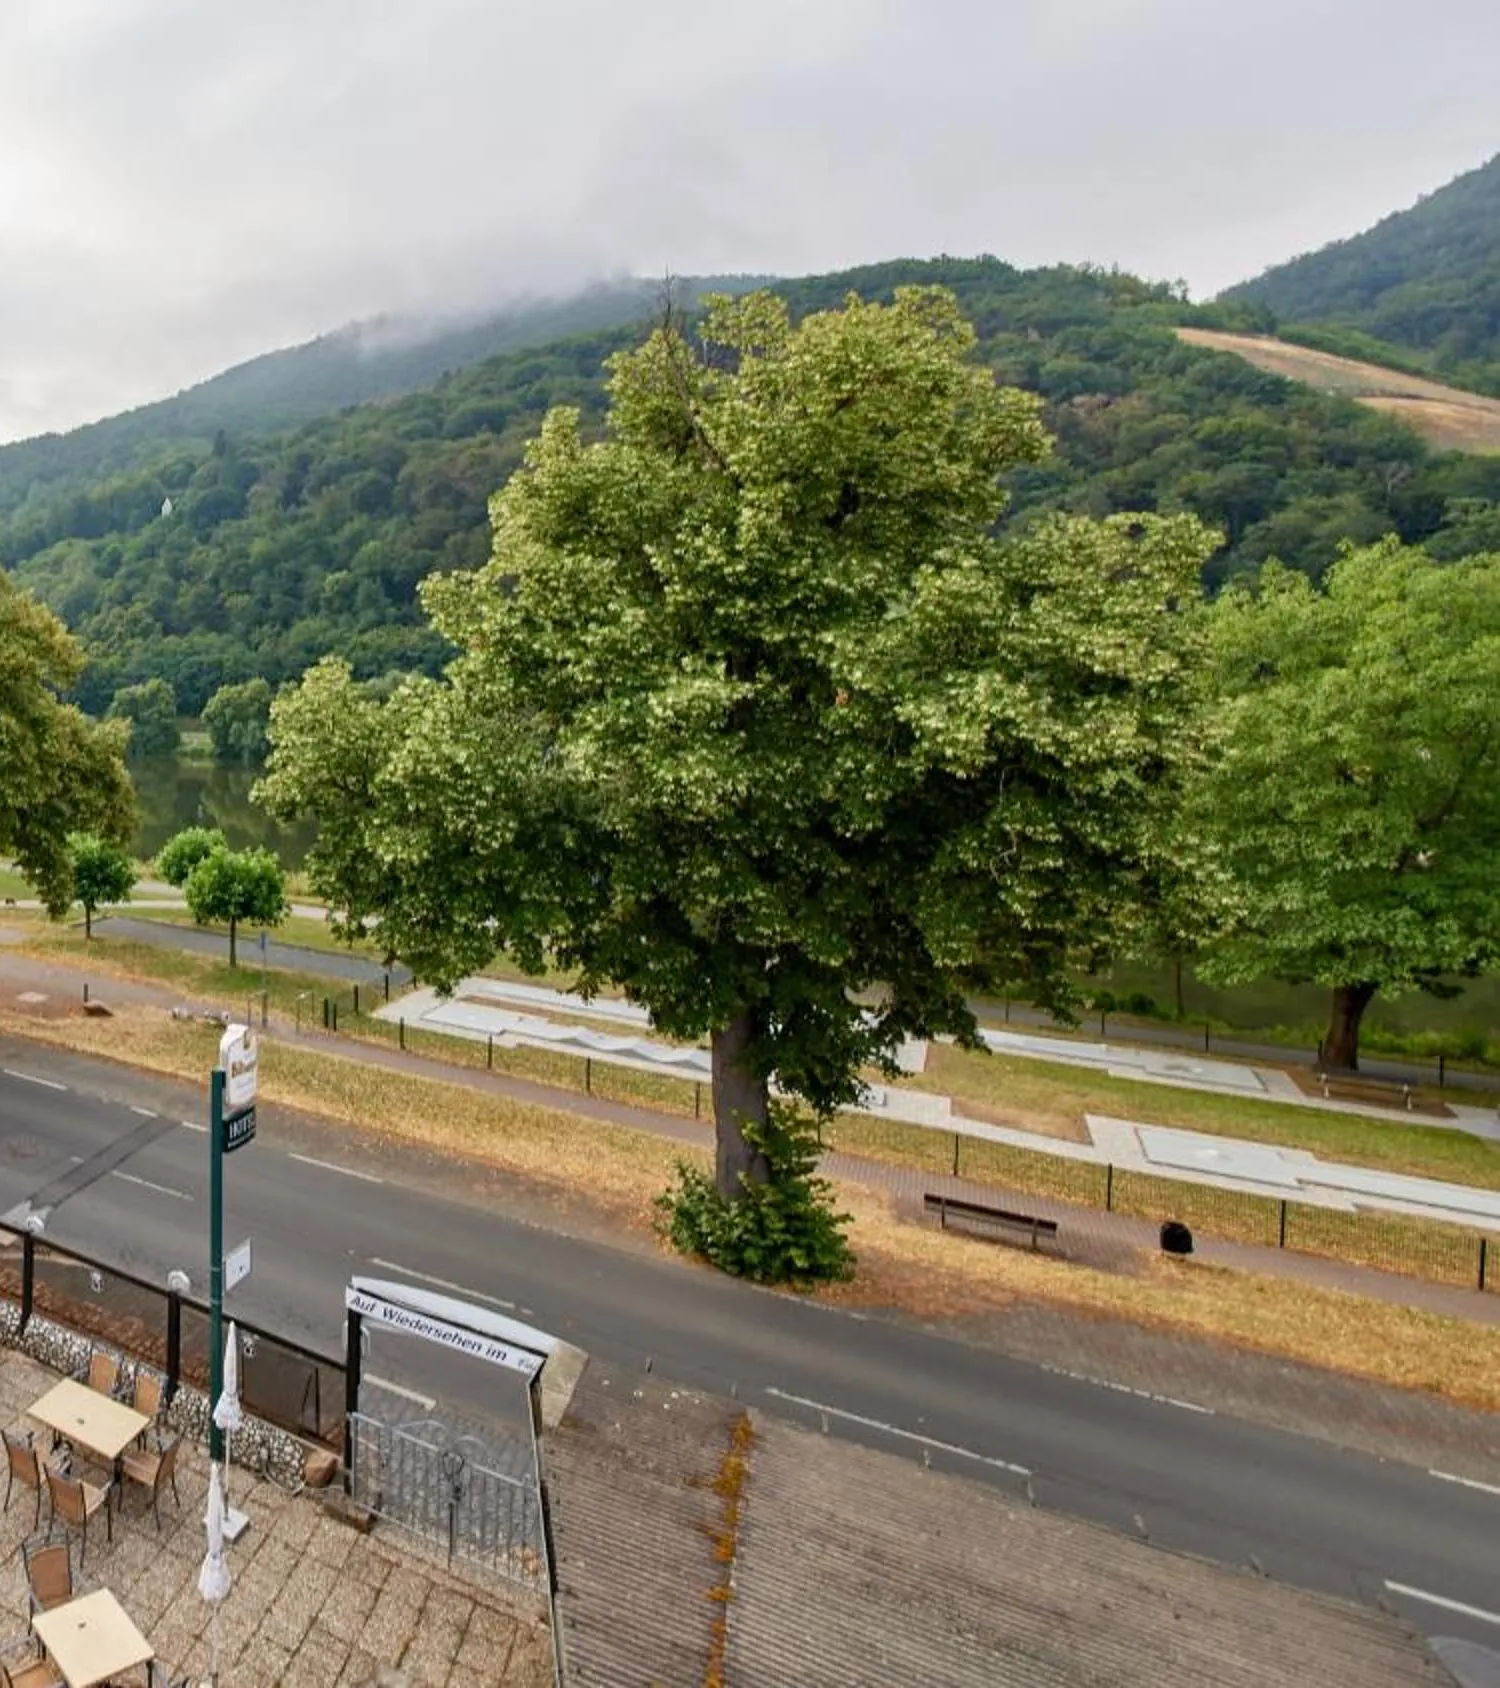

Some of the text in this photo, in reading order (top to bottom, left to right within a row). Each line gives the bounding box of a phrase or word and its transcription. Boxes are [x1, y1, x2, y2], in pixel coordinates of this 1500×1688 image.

[350, 1295, 508, 1361] Auf Wiedersehen im
